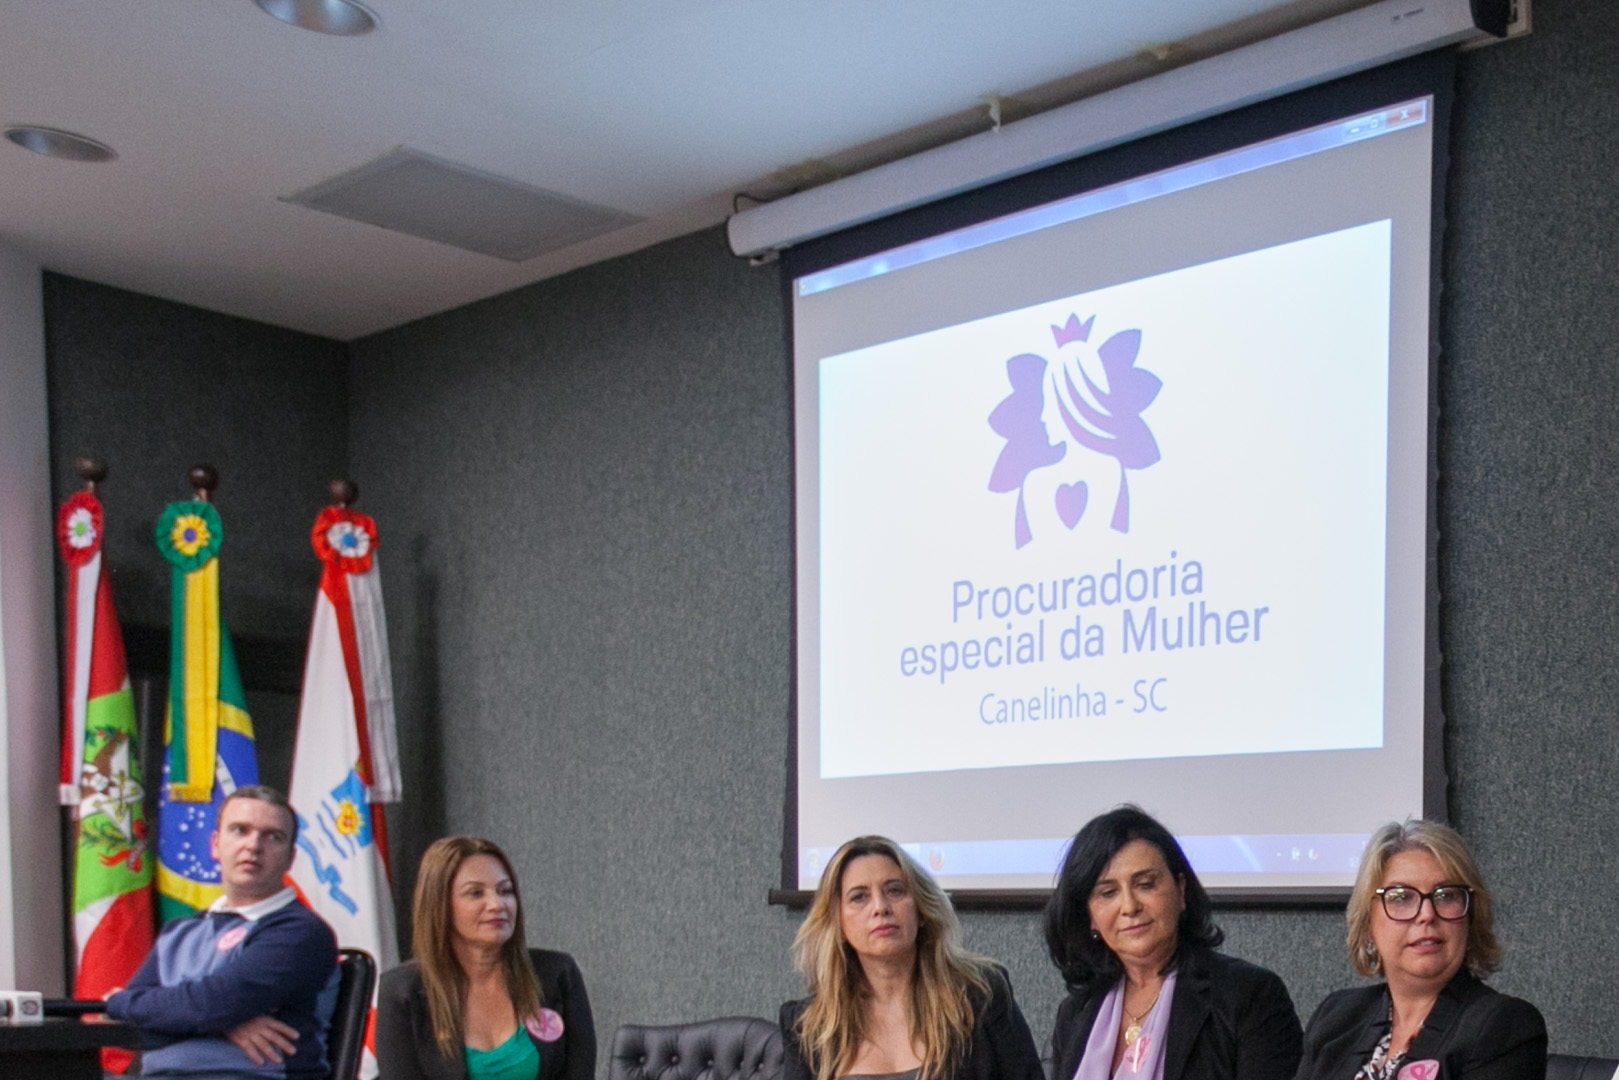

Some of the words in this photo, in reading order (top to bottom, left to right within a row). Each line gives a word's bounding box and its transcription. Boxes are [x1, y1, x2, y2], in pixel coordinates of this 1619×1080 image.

[952, 550, 1203, 623] Procuradoria
[900, 618, 1045, 684] especial
[1059, 614, 1105, 661] da
[1122, 600, 1270, 654] Mulher
[979, 682, 1107, 725] Canelinha
[1132, 677, 1168, 713] SC
